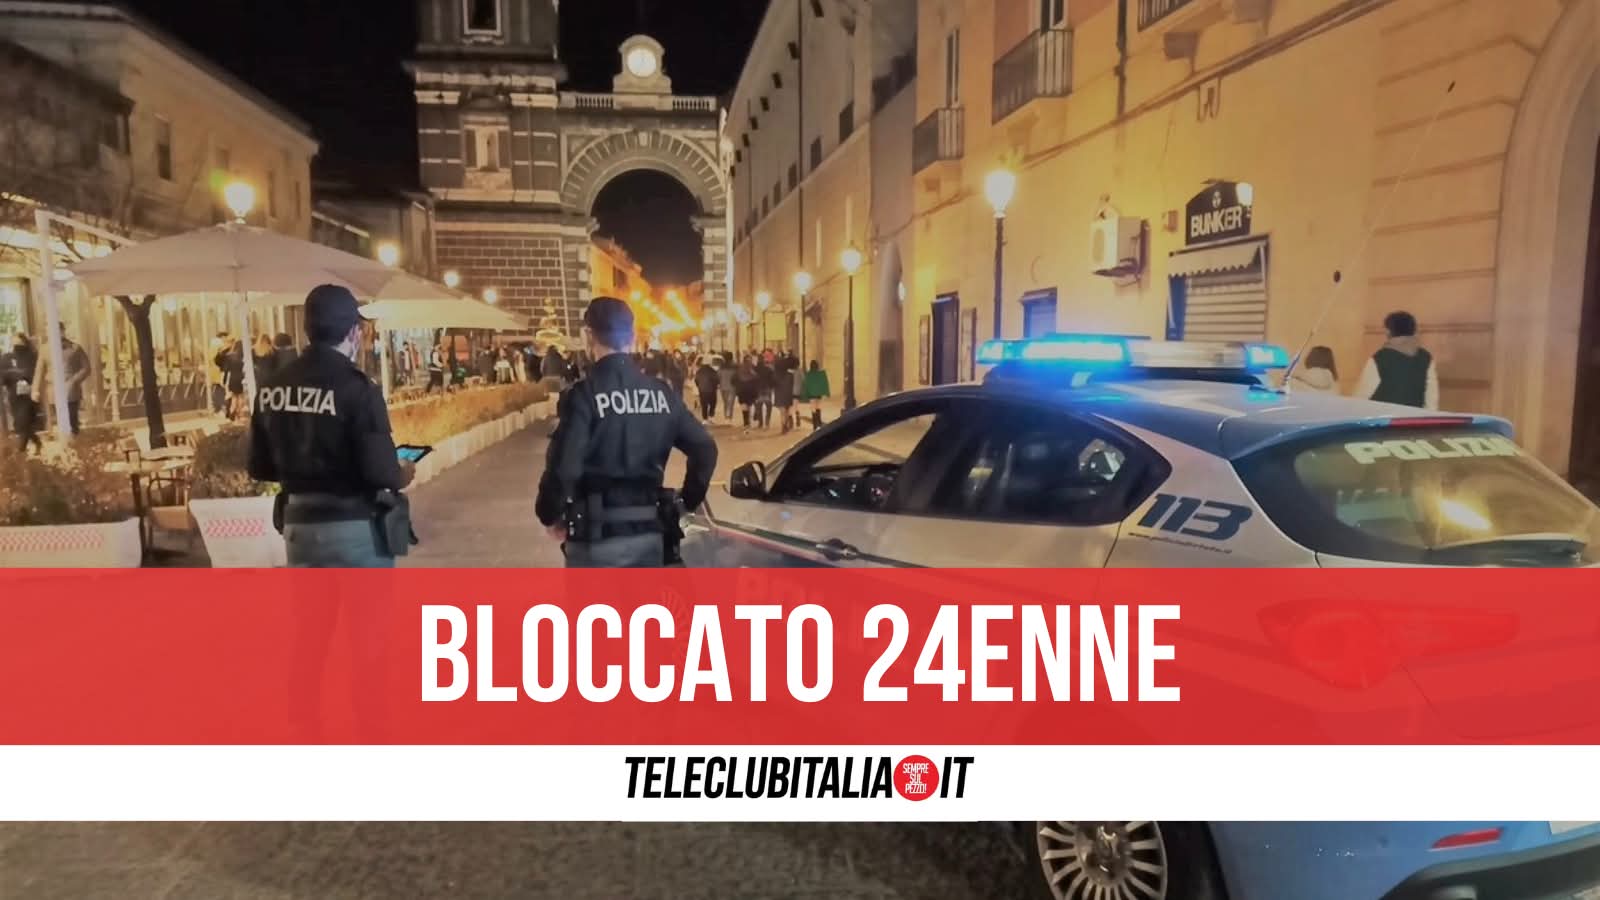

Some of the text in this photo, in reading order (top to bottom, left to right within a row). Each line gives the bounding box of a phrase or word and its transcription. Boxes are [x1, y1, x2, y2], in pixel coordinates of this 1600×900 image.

[1190, 205, 1243, 238] BUNKER
[260, 386, 336, 416] POLIZIA
[595, 388, 671, 418] POLIZIA
[1137, 493, 1253, 541] 113
